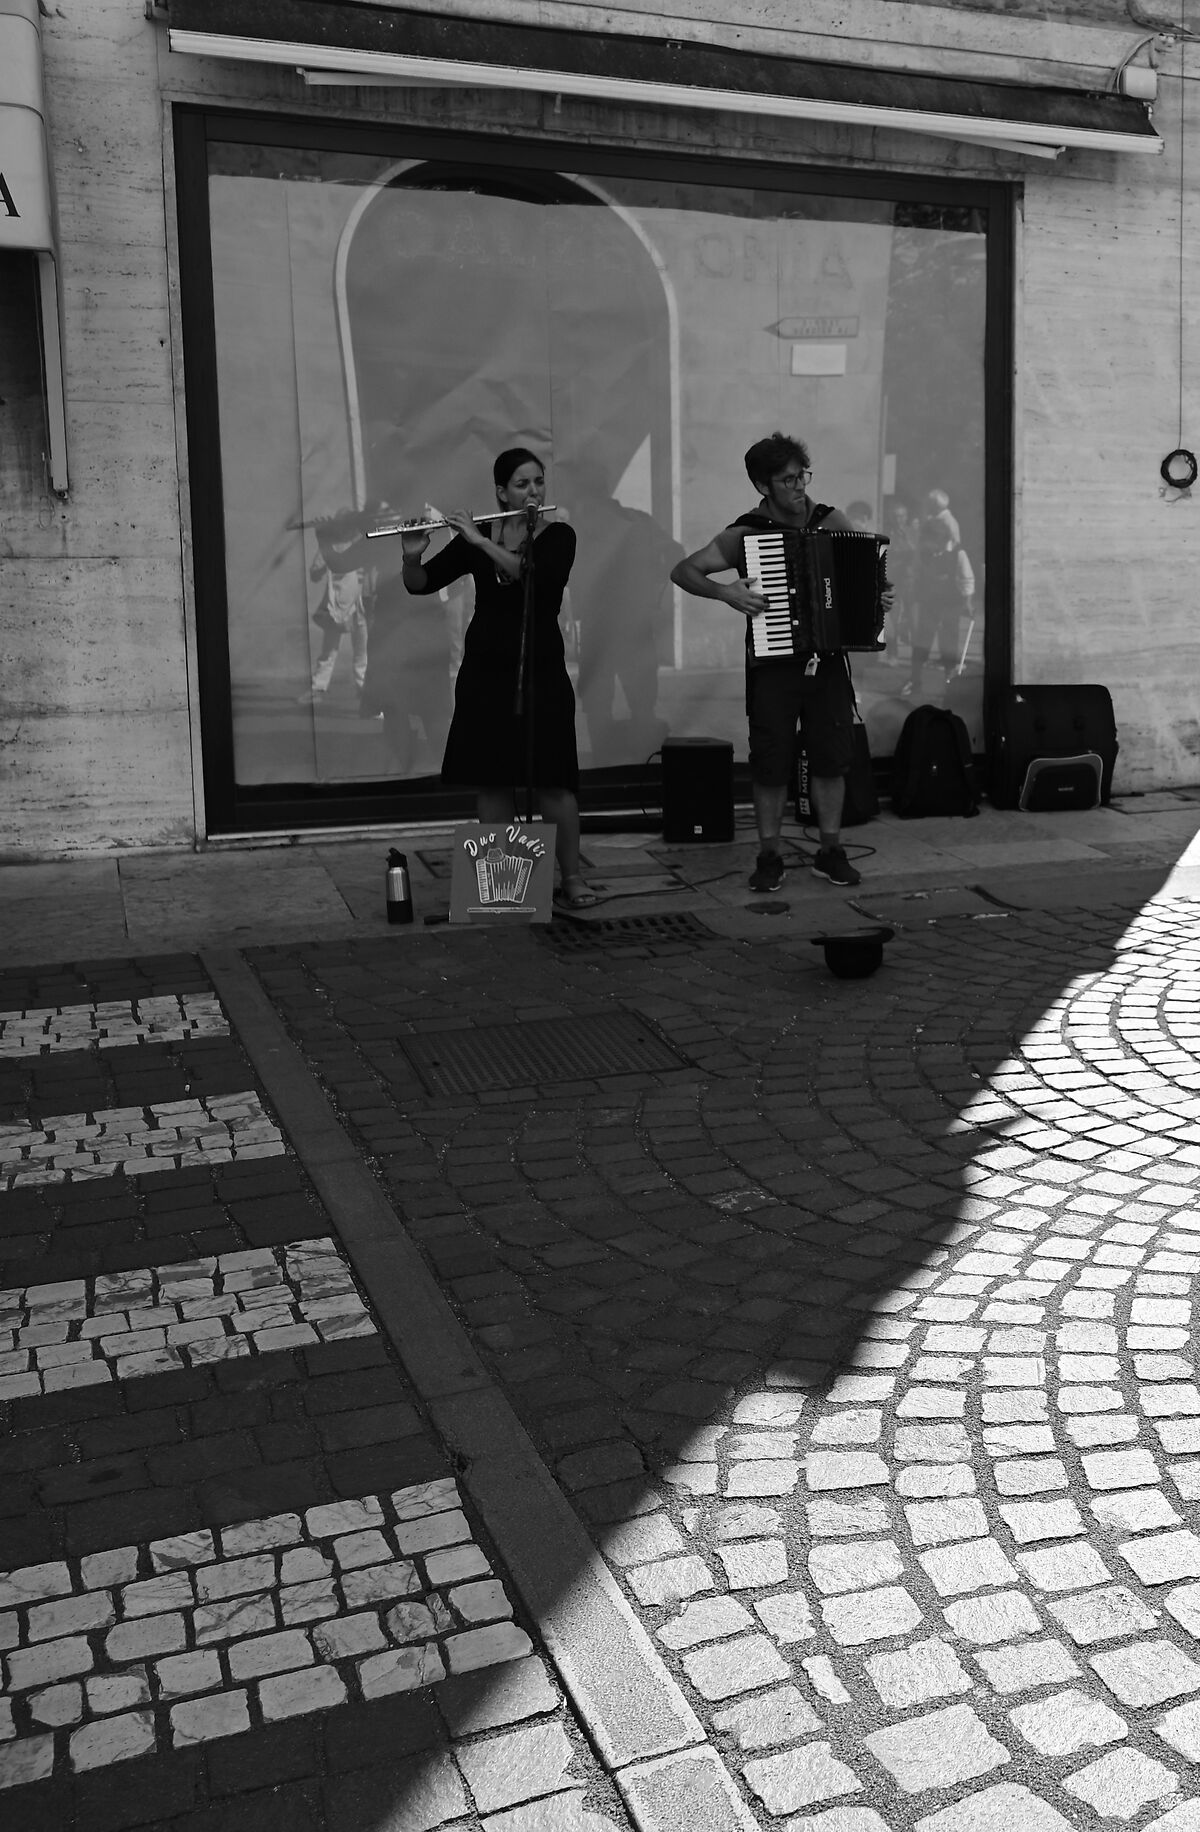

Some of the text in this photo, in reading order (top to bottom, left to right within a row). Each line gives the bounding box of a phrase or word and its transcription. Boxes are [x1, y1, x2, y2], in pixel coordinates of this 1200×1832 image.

[823, 577, 833, 610] Roland
[801, 759, 809, 794] MOVE
[463, 825, 546, 858] Duo Vadis
